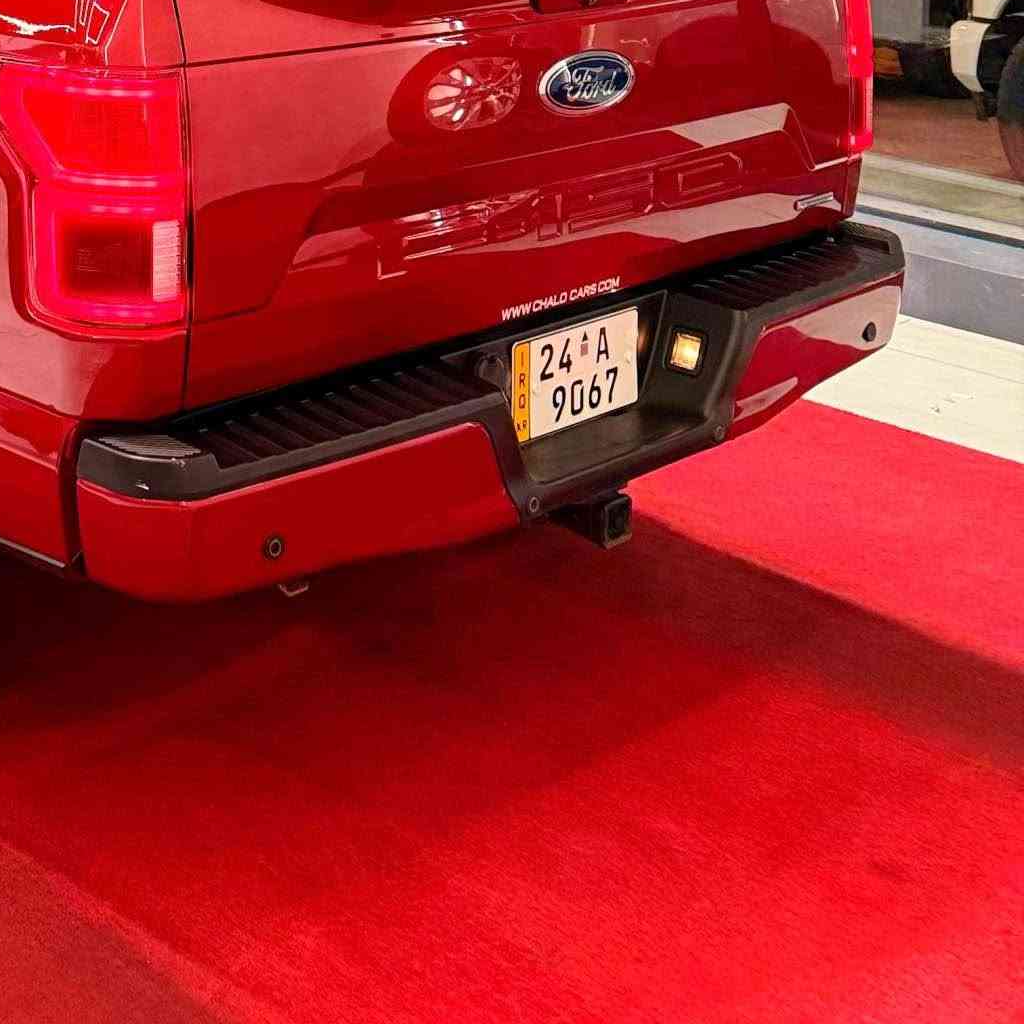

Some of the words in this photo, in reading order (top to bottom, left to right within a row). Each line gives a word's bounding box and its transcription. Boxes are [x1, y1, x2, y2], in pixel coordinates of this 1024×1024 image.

[540, 338, 573, 381] 24
[596, 326, 610, 364] A
[552, 366, 618, 423] 9067
